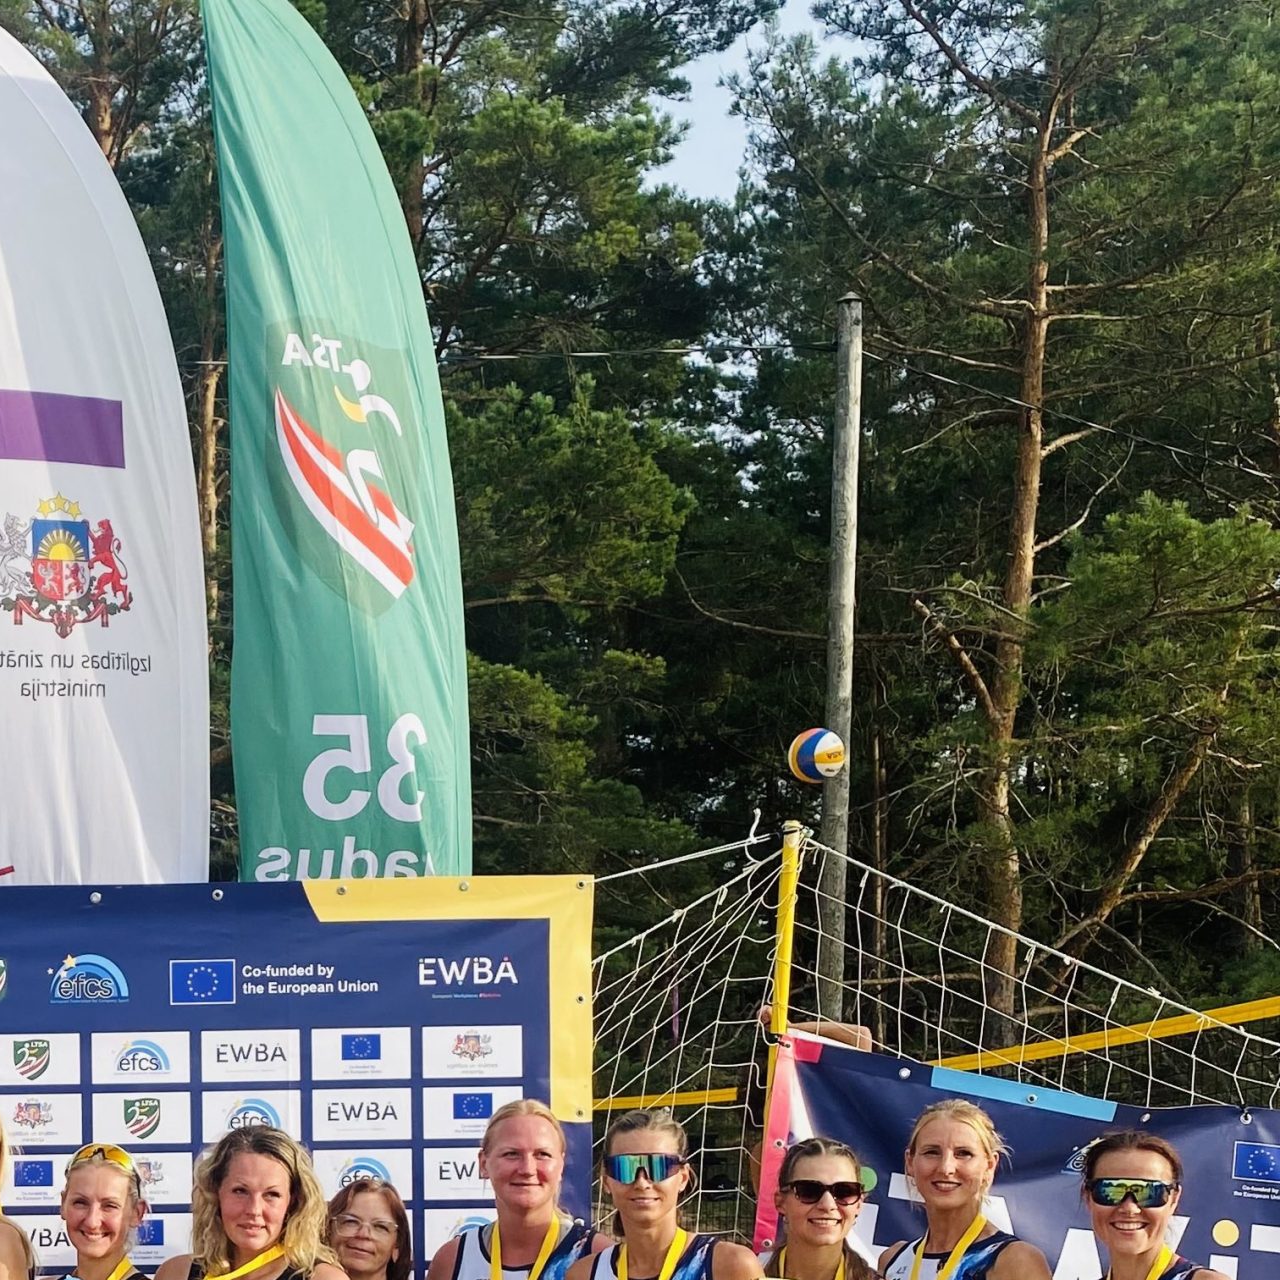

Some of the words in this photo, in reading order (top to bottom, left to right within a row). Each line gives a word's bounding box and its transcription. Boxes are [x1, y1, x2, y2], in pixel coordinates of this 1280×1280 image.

[242, 964, 314, 977] Co-funded
[317, 964, 335, 978] by
[419, 957, 519, 986] EWBA
[58, 972, 114, 999] efcs
[242, 982, 264, 994] the
[268, 981, 334, 996] European
[338, 980, 379, 992] Union
[120, 1053, 160, 1071] efcs
[216, 1043, 287, 1063] EWBA
[327, 1101, 398, 1121] EWBA
[230, 1112, 269, 1130] efcs
[439, 1161, 488, 1180] EW
[31, 1227, 71, 1247] BA
